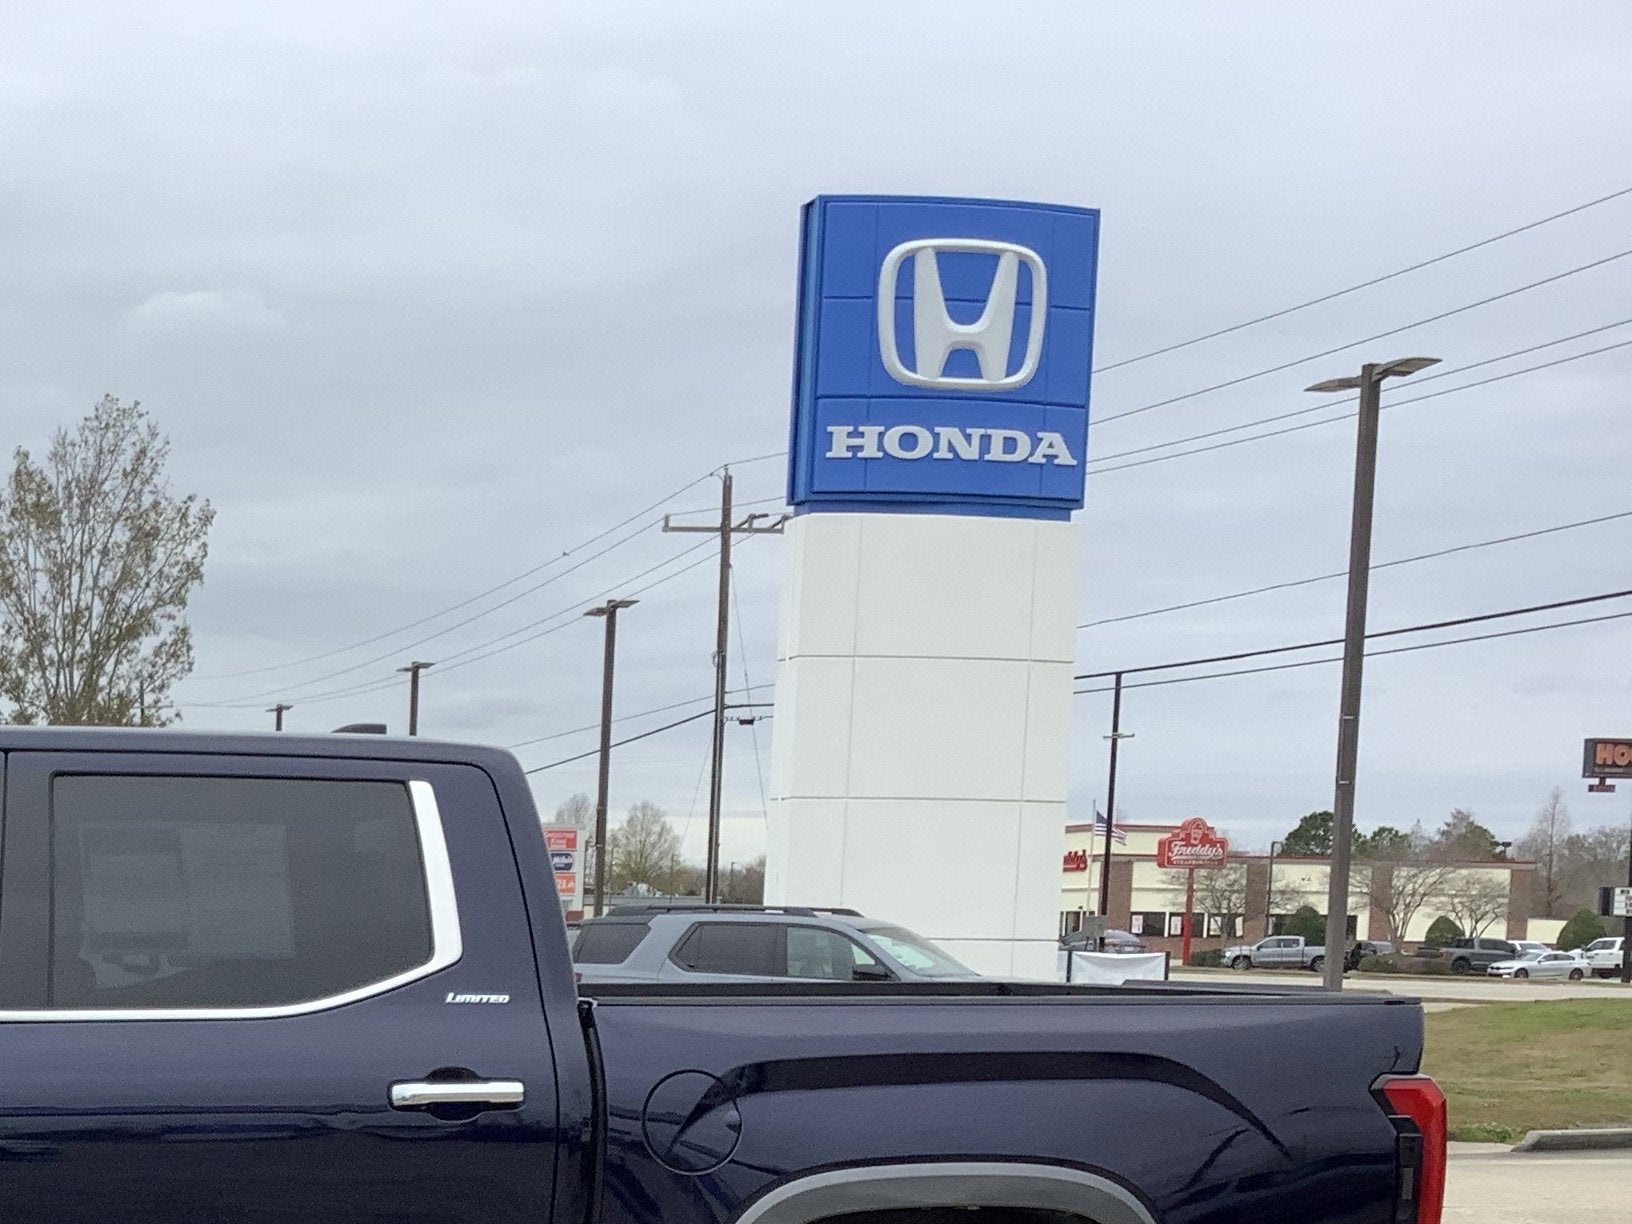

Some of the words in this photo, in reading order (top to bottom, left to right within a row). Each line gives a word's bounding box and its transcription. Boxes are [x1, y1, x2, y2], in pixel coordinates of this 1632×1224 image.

[825, 425, 1077, 465] HONDA
[1595, 743, 1632, 766] HO
[1169, 841, 1224, 859] Freddy's
